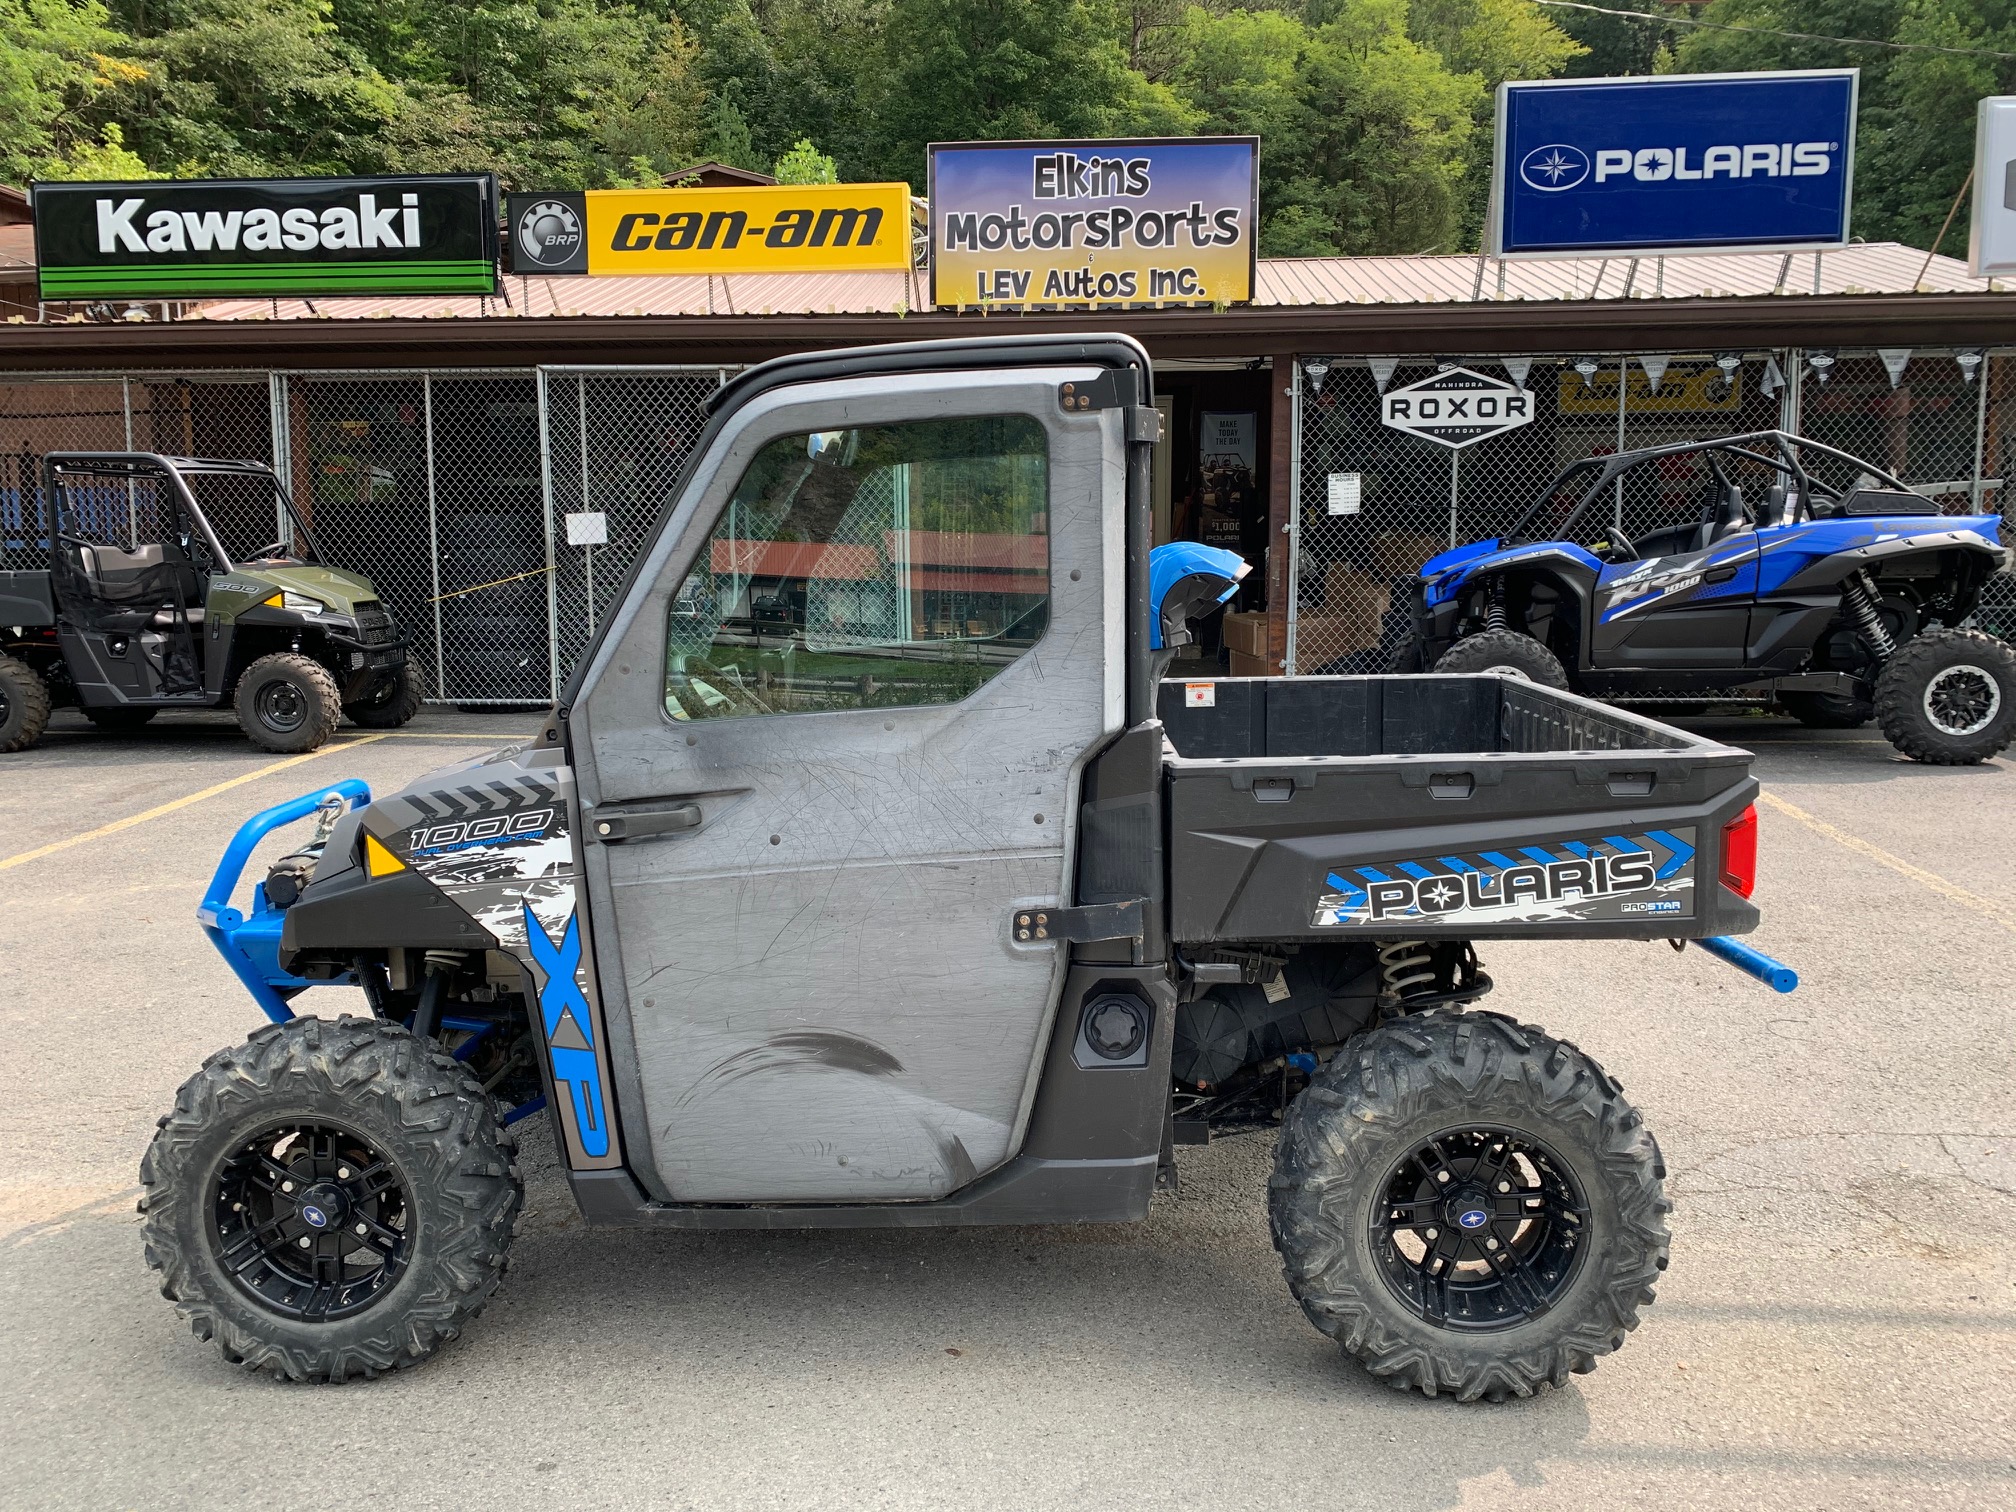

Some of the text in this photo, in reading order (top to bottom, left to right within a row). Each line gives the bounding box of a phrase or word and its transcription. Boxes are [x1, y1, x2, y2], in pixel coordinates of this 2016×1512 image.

[1034, 152, 1151, 199] Elkins
[1595, 142, 1830, 183] POLARIS
[96, 193, 421, 253] Kawasaki
[544, 235, 578, 245] BRP
[610, 207, 883, 251] can-am
[977, 266, 1207, 301] LEV Autos Inc.
[1390, 397, 1526, 419] ROXOR
[213, 581, 259, 594] 500
[1604, 554, 1712, 611] KRX
[1663, 575, 1701, 594] 1000
[410, 808, 554, 850] 1000
[414, 847, 443, 857] DUAL
[446, 835, 514, 852] OVERHEAD
[1367, 851, 1657, 922] POLARIS
[521, 893, 611, 1158] XP
